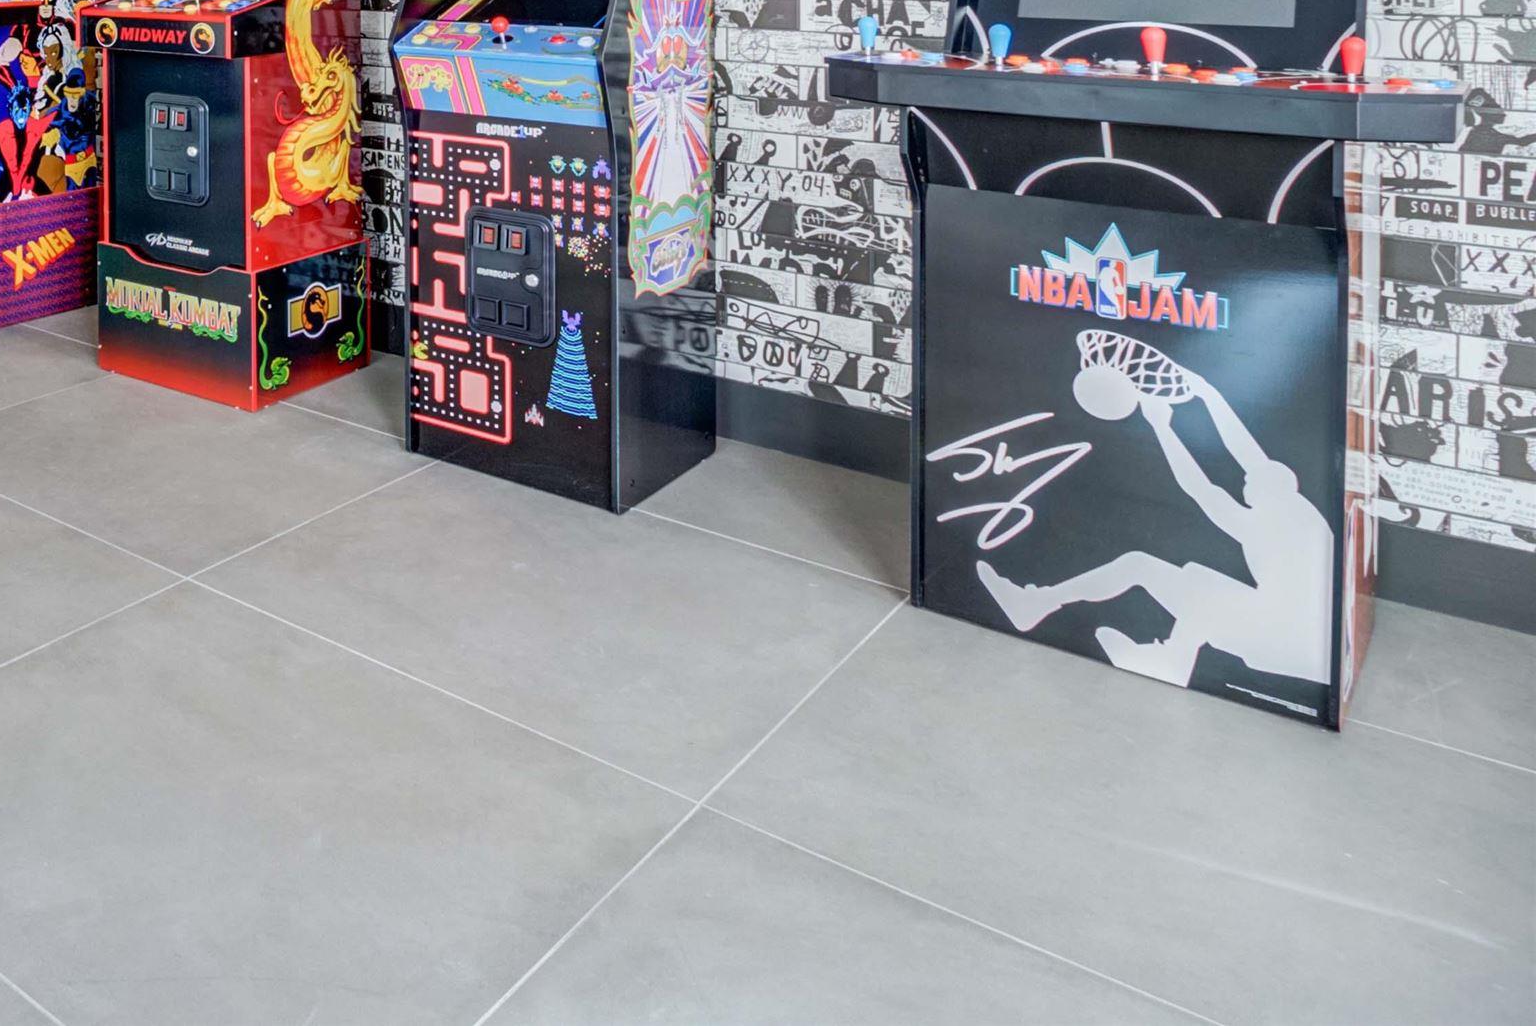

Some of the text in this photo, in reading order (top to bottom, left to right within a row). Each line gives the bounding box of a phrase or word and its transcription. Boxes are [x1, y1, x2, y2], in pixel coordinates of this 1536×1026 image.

[119, 26, 187, 45] MIDWAY
[2, 226, 77, 292] X-MEN
[105, 277, 242, 340] MORTAL KOMBAT
[1016, 263, 1220, 331] NBA JAM
